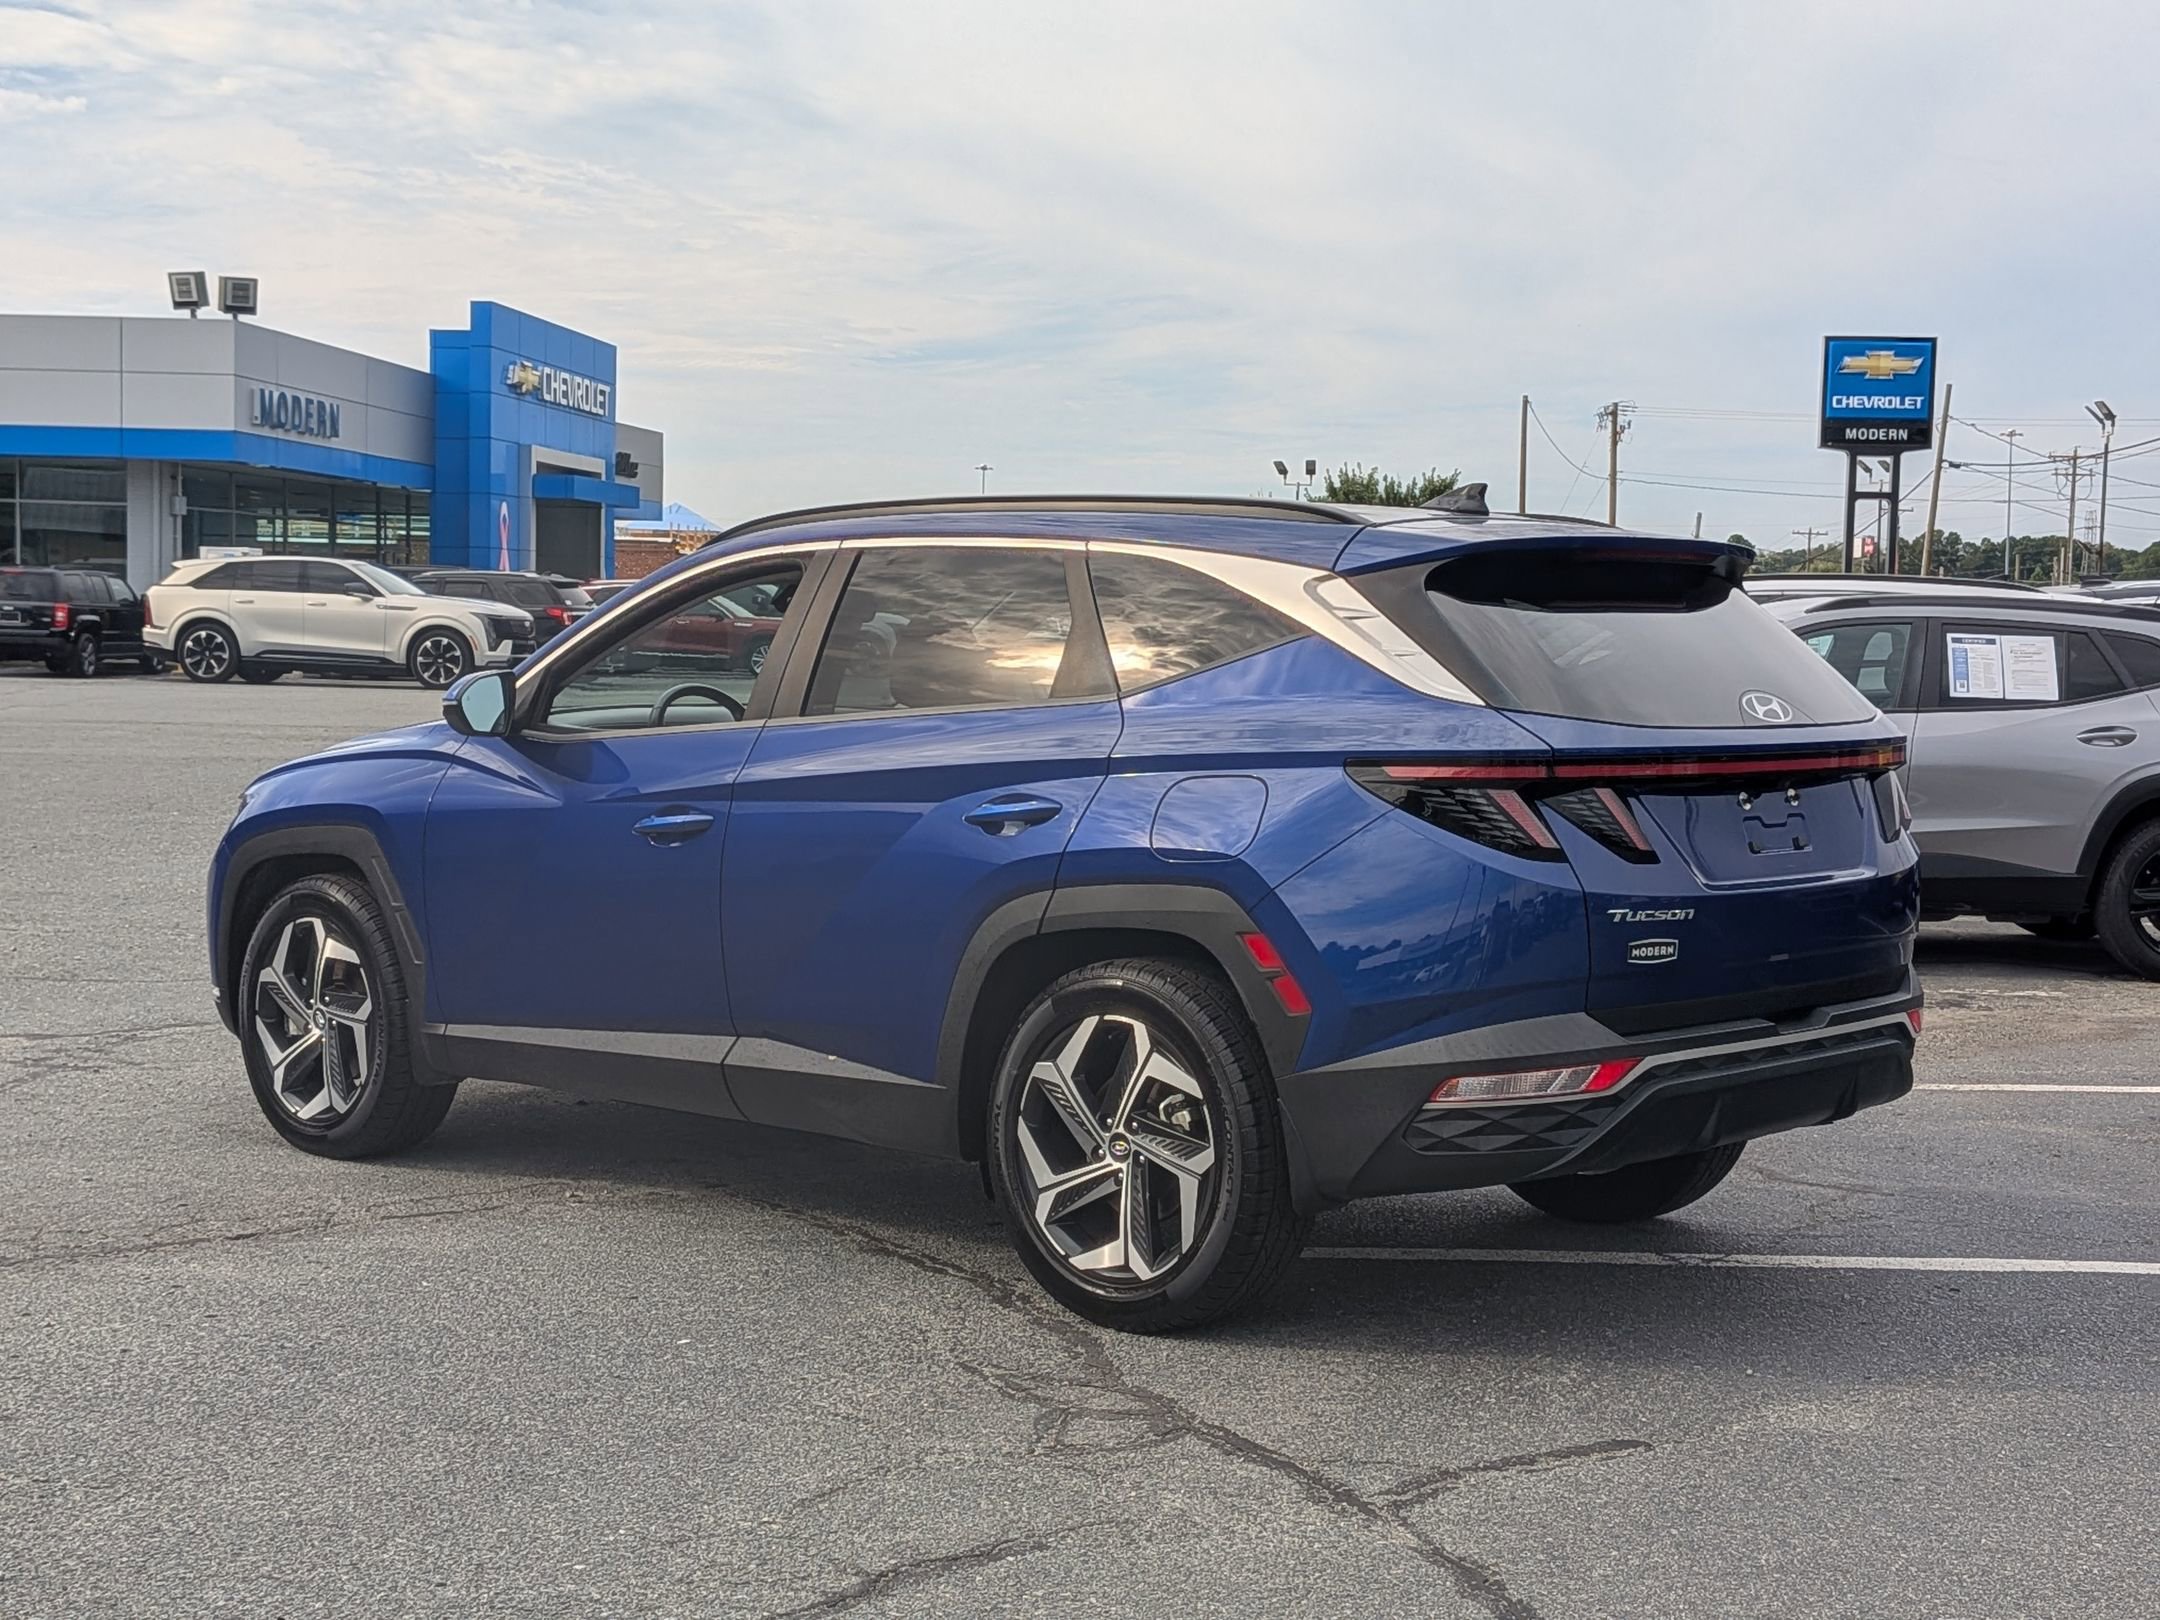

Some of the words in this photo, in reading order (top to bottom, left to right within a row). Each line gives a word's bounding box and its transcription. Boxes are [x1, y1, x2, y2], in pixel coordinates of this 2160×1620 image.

[543, 367, 610, 416] CHEVROLET
[1832, 395, 1925, 409] CHEVROLET
[255, 388, 340, 438] MODERN
[1845, 428, 1908, 440] MODERN
[1631, 945, 1674, 957] MODERN
